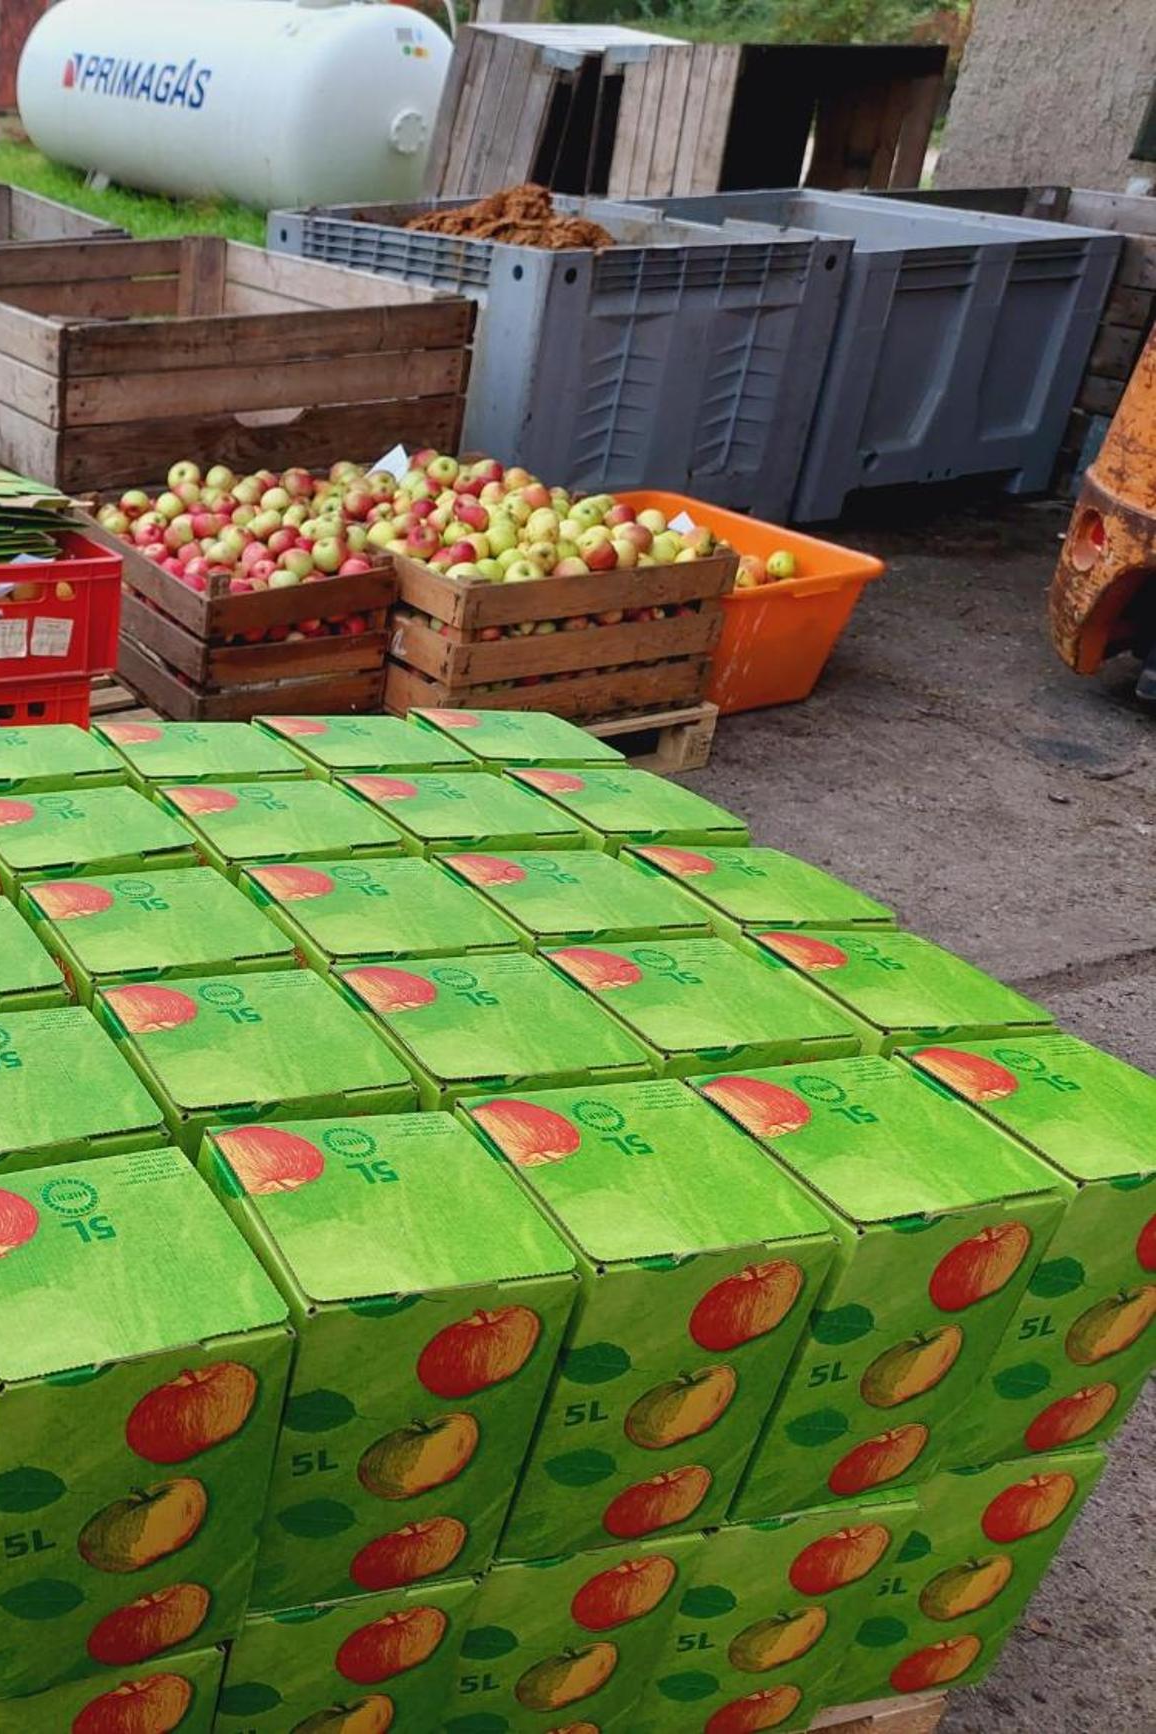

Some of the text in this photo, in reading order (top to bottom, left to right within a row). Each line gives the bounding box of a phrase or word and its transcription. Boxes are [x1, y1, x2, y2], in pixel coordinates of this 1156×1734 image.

[435, 789, 466, 799] 5L
[256, 798, 288, 810] 5L
[49, 808, 86, 820] 5L
[546, 873, 580, 884] 5L
[732, 865, 768, 877] 5L
[349, 884, 388, 896] 5L
[130, 897, 169, 911] 5L
[864, 956, 906, 971] 5L
[659, 971, 703, 984] 5L
[456, 990, 499, 1006] 5L
[217, 1007, 262, 1024] 5L
[1033, 1074, 1081, 1091] 5L
[832, 1103, 878, 1125] 5L
[601, 1134, 654, 1156] 5L
[346, 1161, 399, 1185] 5L
[62, 1216, 116, 1242] 5L
[1018, 1316, 1056, 1339] 5L
[807, 1361, 848, 1387] 5L
[563, 1401, 608, 1426] 5L
[291, 1450, 339, 1475] 5L
[3, 1529, 56, 1558] 5L
[676, 1632, 715, 1651] 5L
[459, 1673, 499, 1693] 5L
